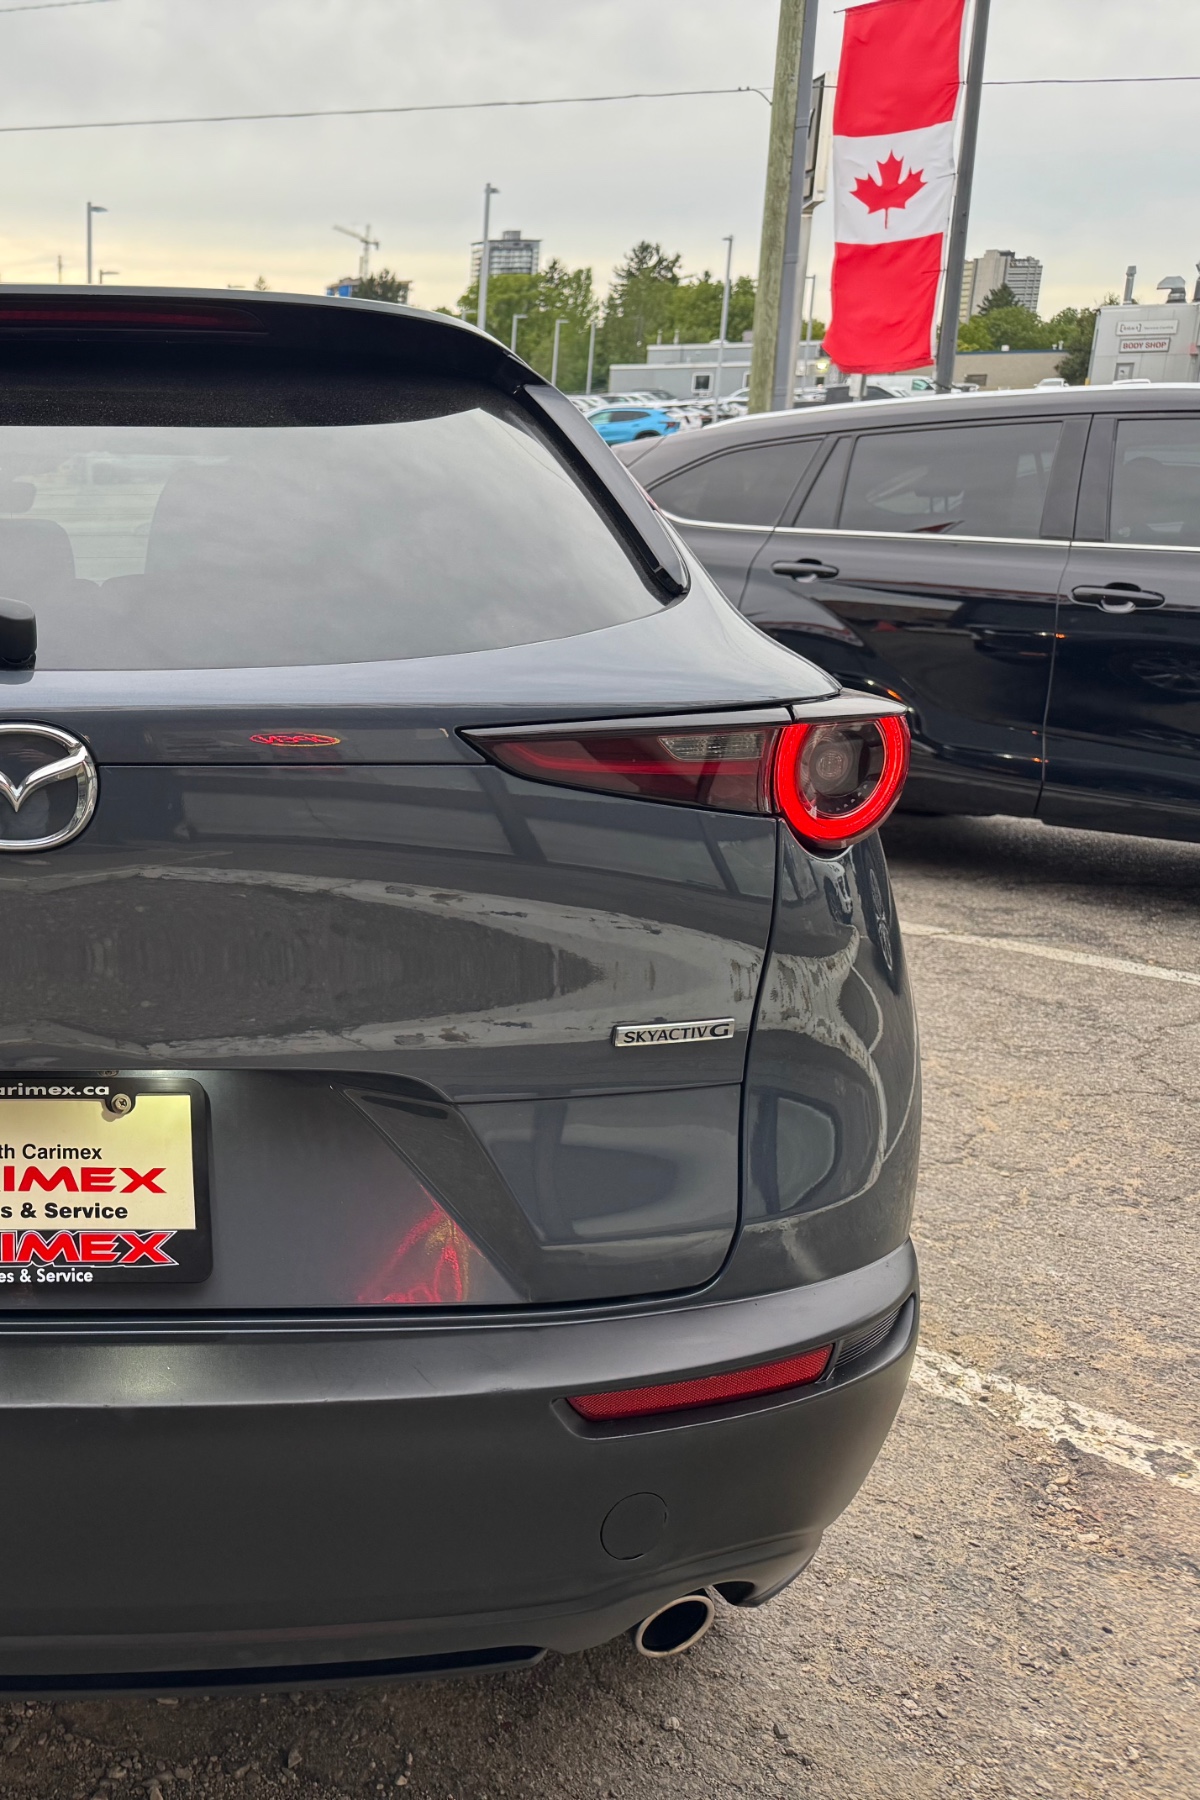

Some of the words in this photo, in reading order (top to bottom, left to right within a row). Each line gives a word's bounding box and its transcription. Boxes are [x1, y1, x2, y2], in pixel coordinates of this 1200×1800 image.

[1122, 342, 1144, 350] BODY
[1145, 341, 1167, 349] SHOP
[22, 1143, 102, 1160] Carimex
[20, 1202, 37, 1219] &
[44, 1202, 129, 1219] Service
[19, 1269, 31, 1284] &
[36, 1268, 94, 1284] Service
